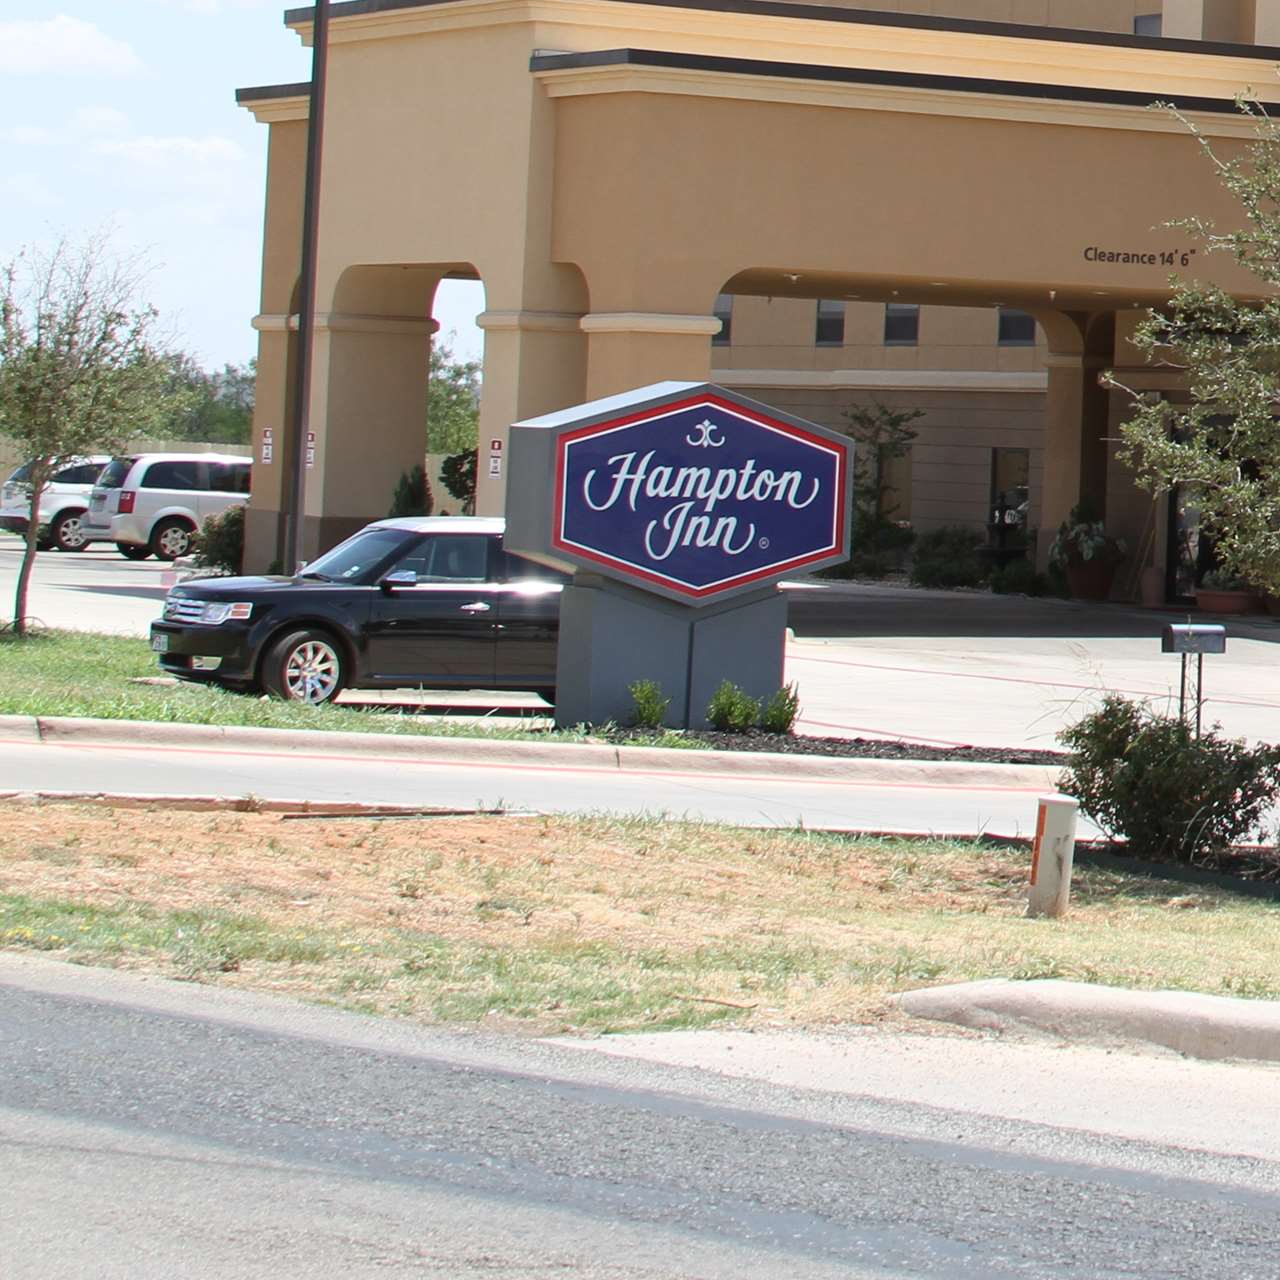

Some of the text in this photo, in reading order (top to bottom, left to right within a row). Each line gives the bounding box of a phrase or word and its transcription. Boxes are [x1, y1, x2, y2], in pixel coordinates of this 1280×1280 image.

[1083, 247, 1196, 267] Clearance 14' 6"
[583, 449, 820, 512] Hampton
[645, 501, 756, 561] Inn
